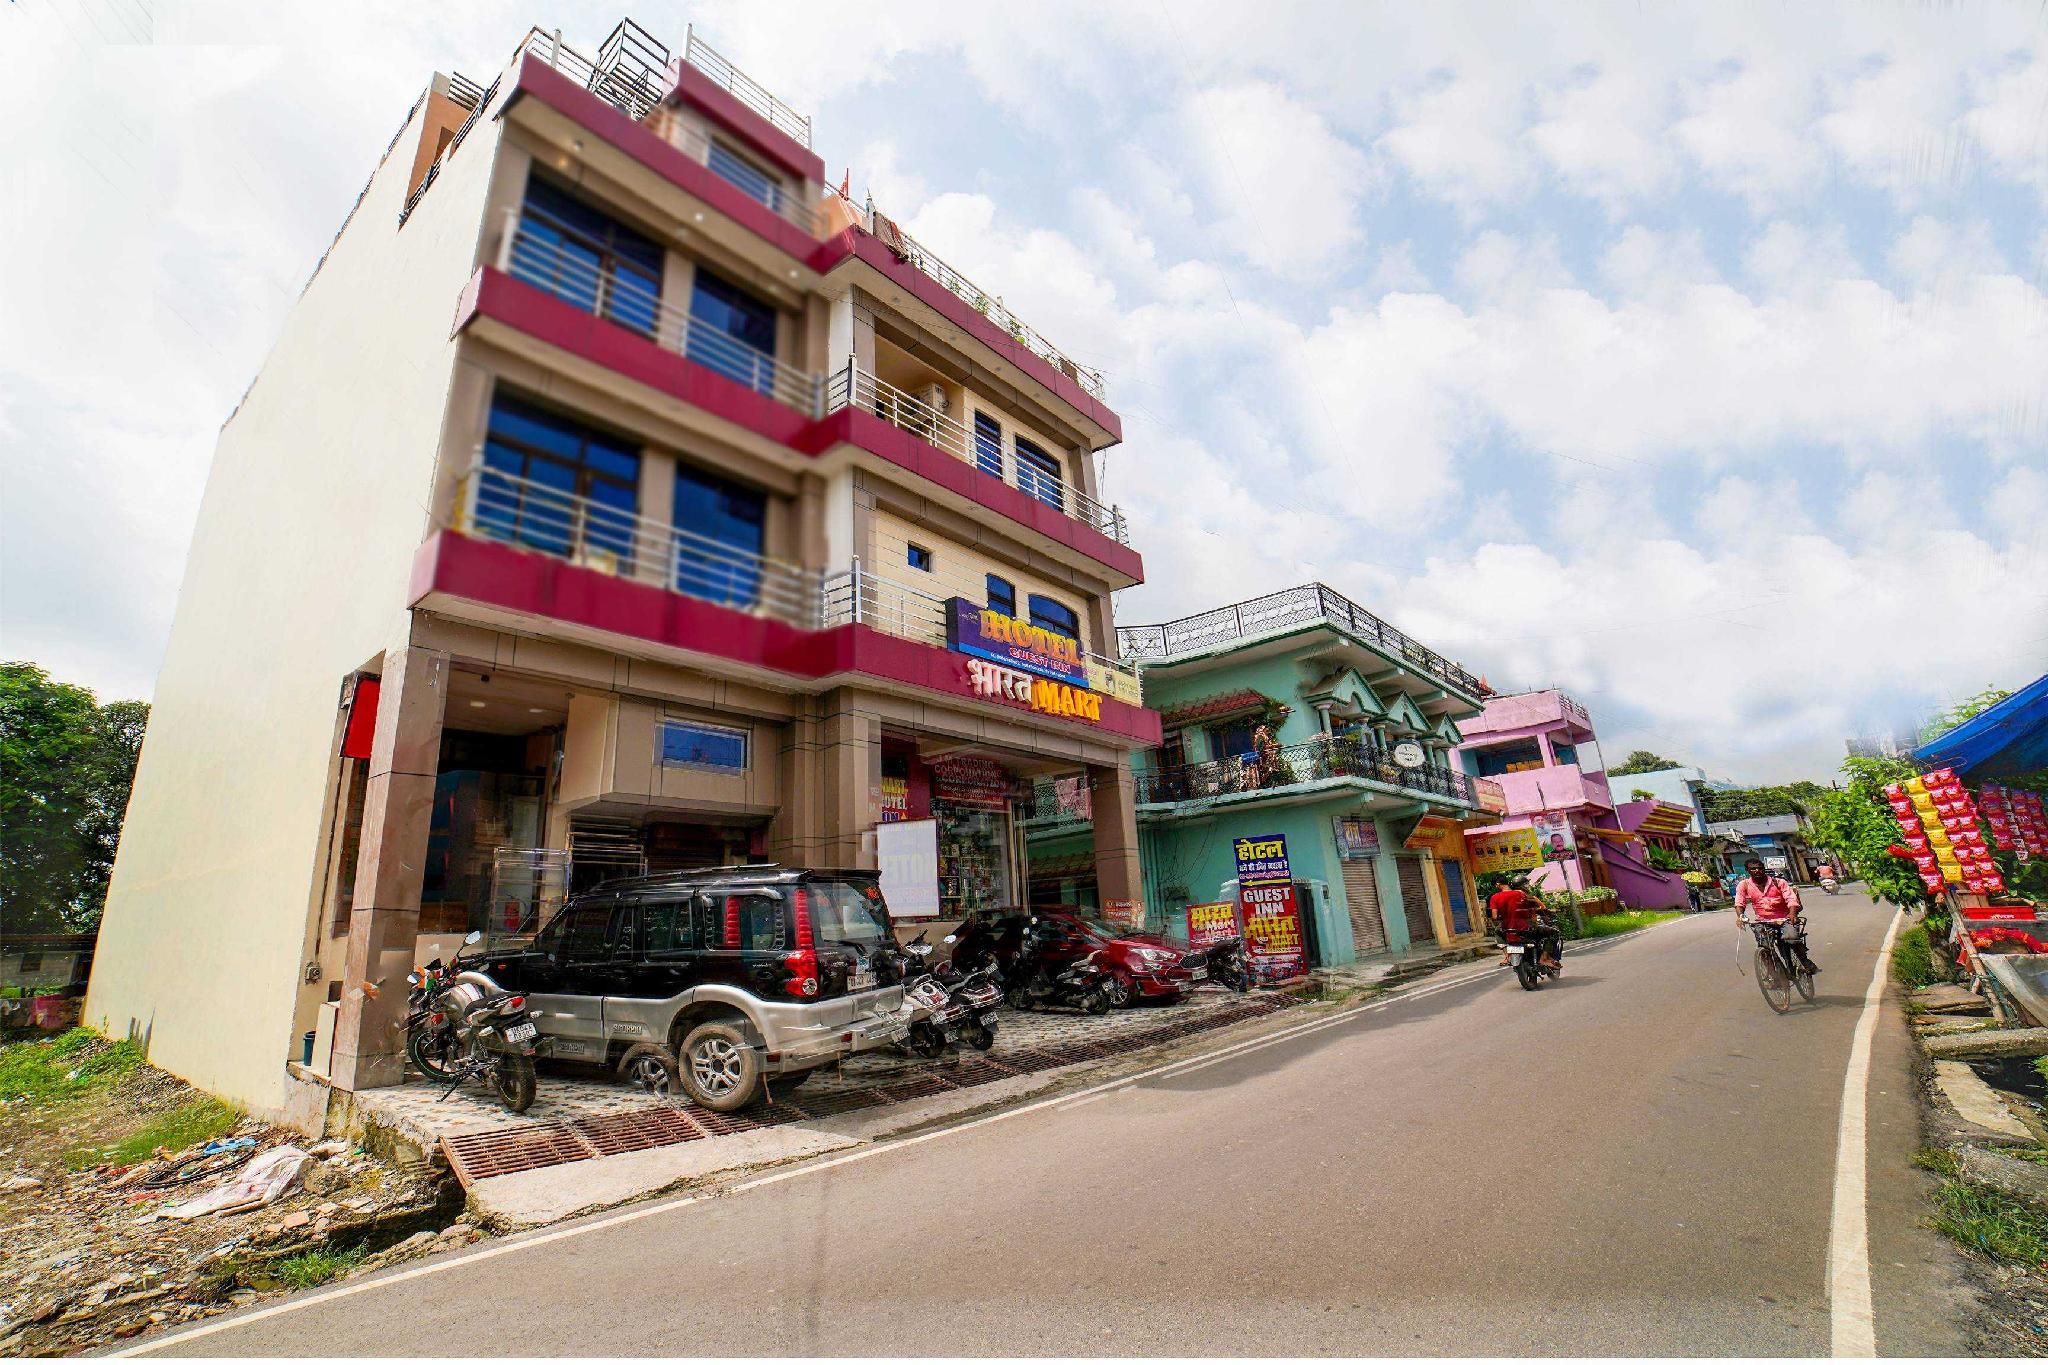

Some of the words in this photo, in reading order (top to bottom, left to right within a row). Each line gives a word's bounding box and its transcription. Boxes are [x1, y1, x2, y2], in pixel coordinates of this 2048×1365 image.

[979, 609, 1084, 667] HOTEL
[1009, 646, 1048, 667] GUEST
[967, 658, 1033, 703] भारत
[1031, 679, 1102, 721] MART
[1236, 839, 1284, 860] होटल
[1243, 887, 1290, 903] GUEST
[1255, 902, 1284, 915] INN
